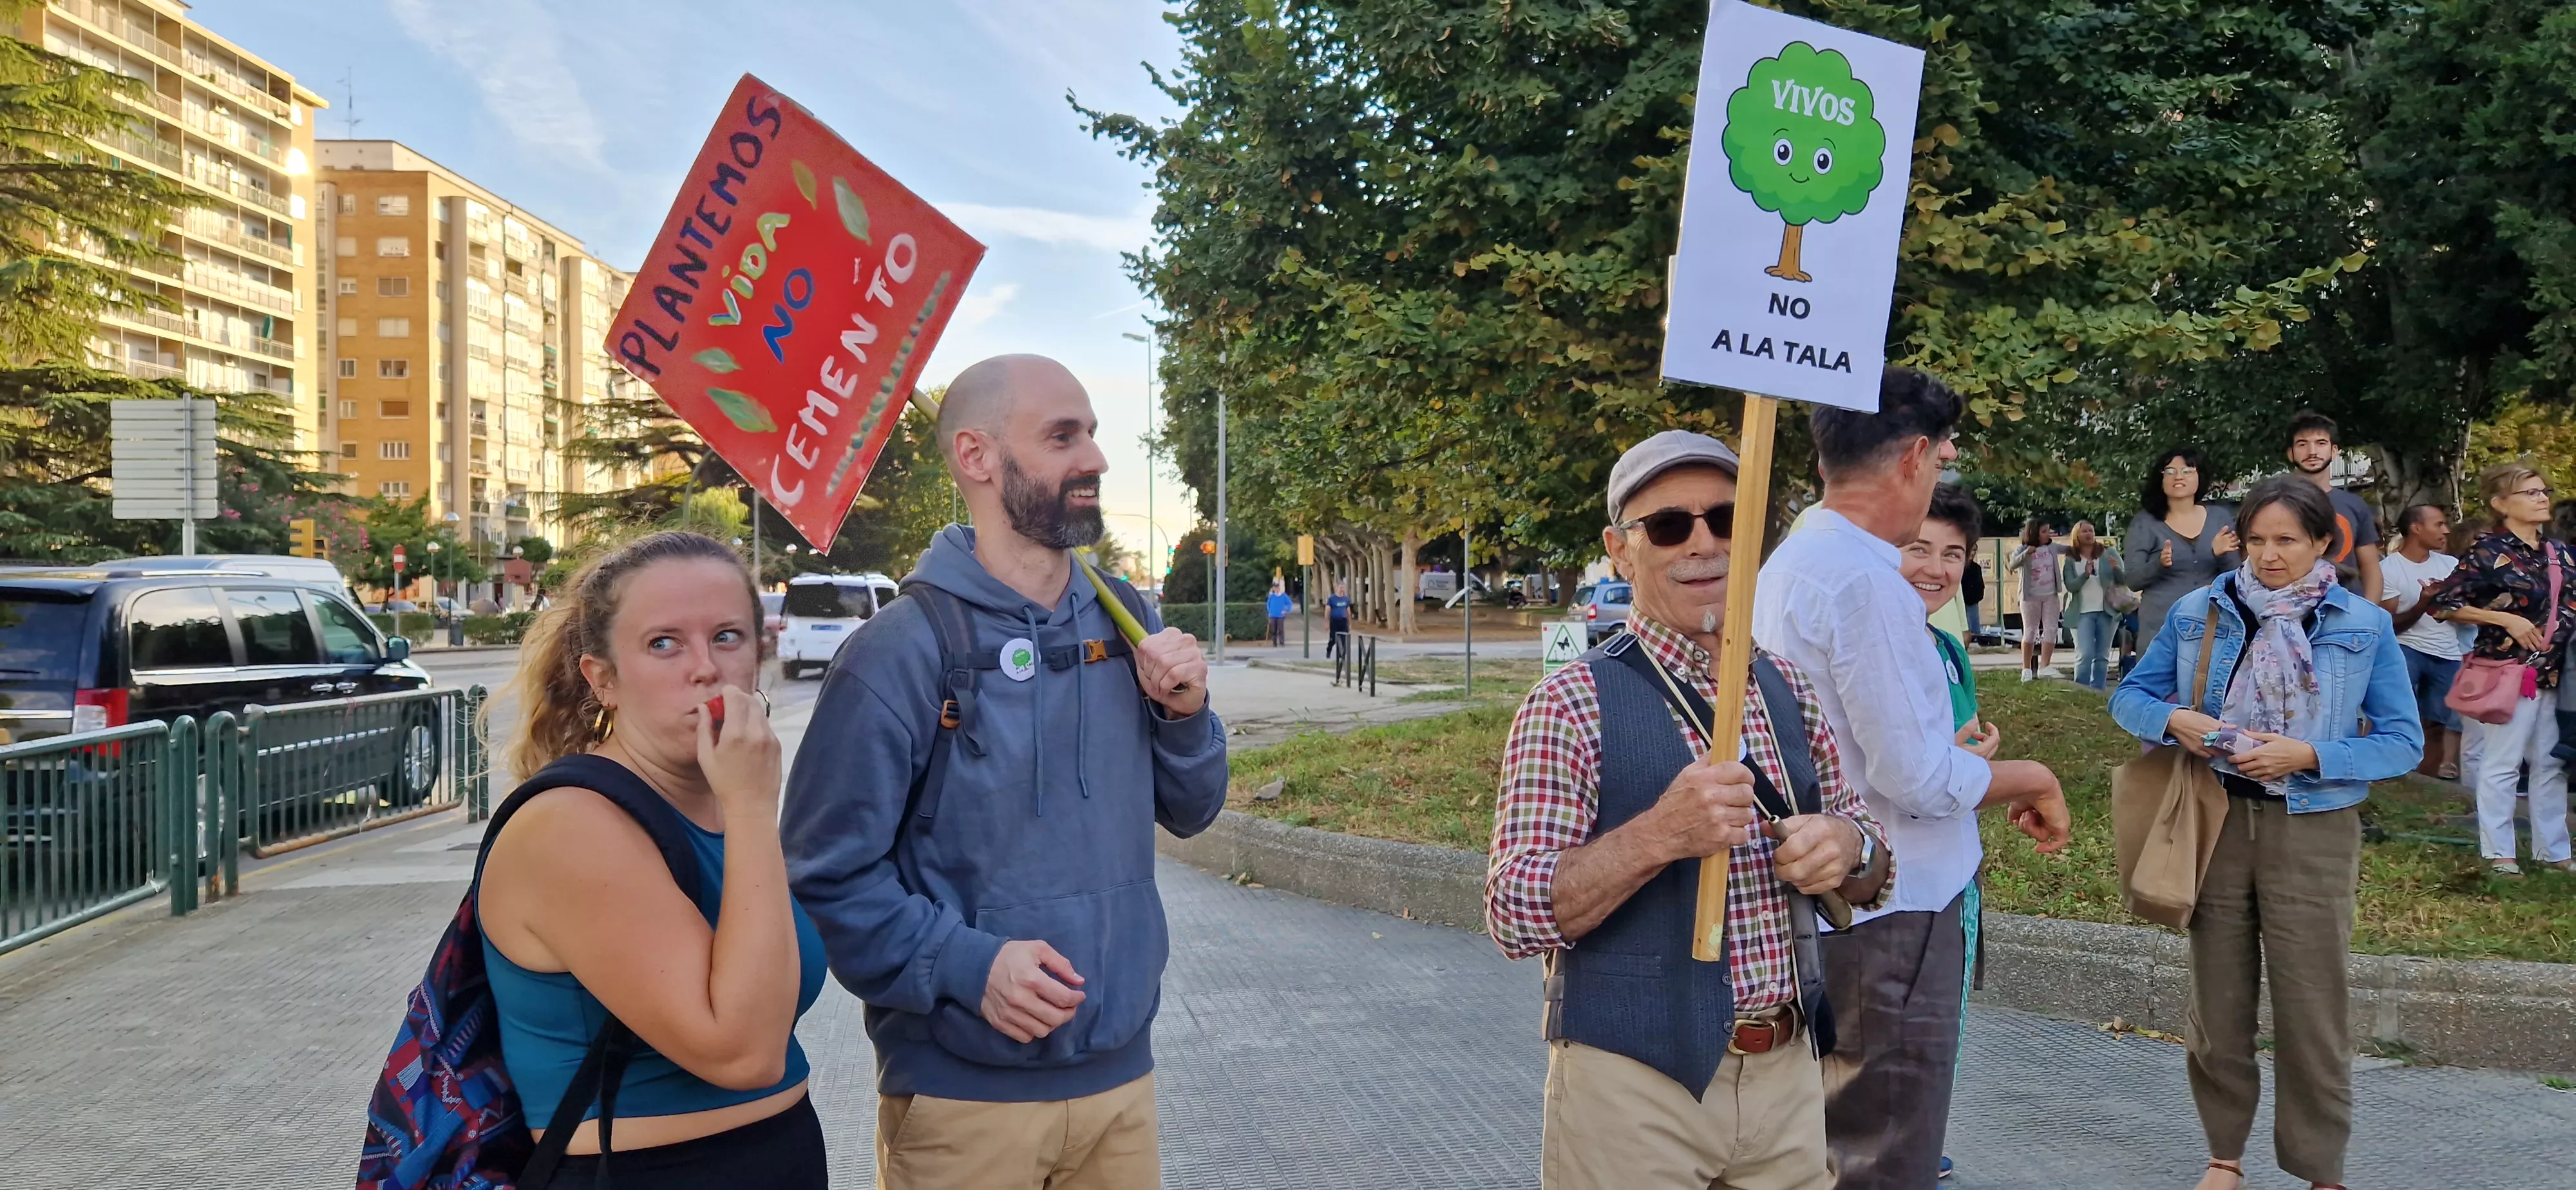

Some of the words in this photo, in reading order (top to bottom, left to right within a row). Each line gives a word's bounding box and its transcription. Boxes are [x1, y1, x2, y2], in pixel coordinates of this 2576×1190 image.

[1771, 79, 1856, 126] VIVOS
[620, 95, 781, 376] PLANTEMOS
[762, 267, 814, 364] NO
[1768, 292, 1811, 319] NO
[770, 232, 918, 507] CEMENTO
[1710, 329, 1732, 353] A
[1739, 333, 1775, 360] LA
[1783, 340, 1852, 373] TALA
